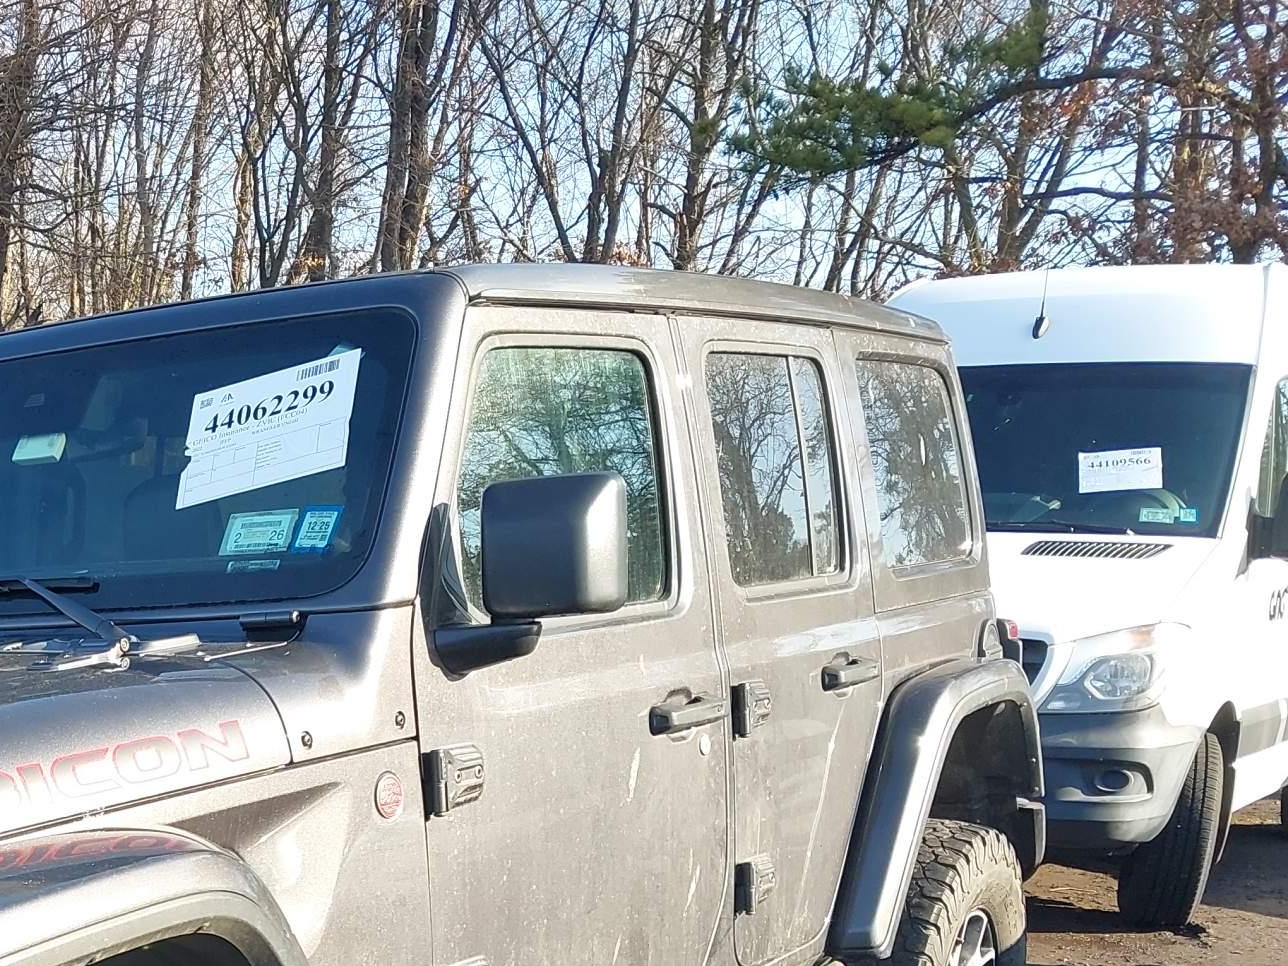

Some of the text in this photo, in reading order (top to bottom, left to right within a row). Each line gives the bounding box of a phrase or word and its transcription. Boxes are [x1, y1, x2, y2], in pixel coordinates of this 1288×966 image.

[204, 380, 335, 434] 44062299
[1087, 457, 1152, 469] 44109566
[233, 532, 243, 544] 2
[268, 529, 286, 541] 26
